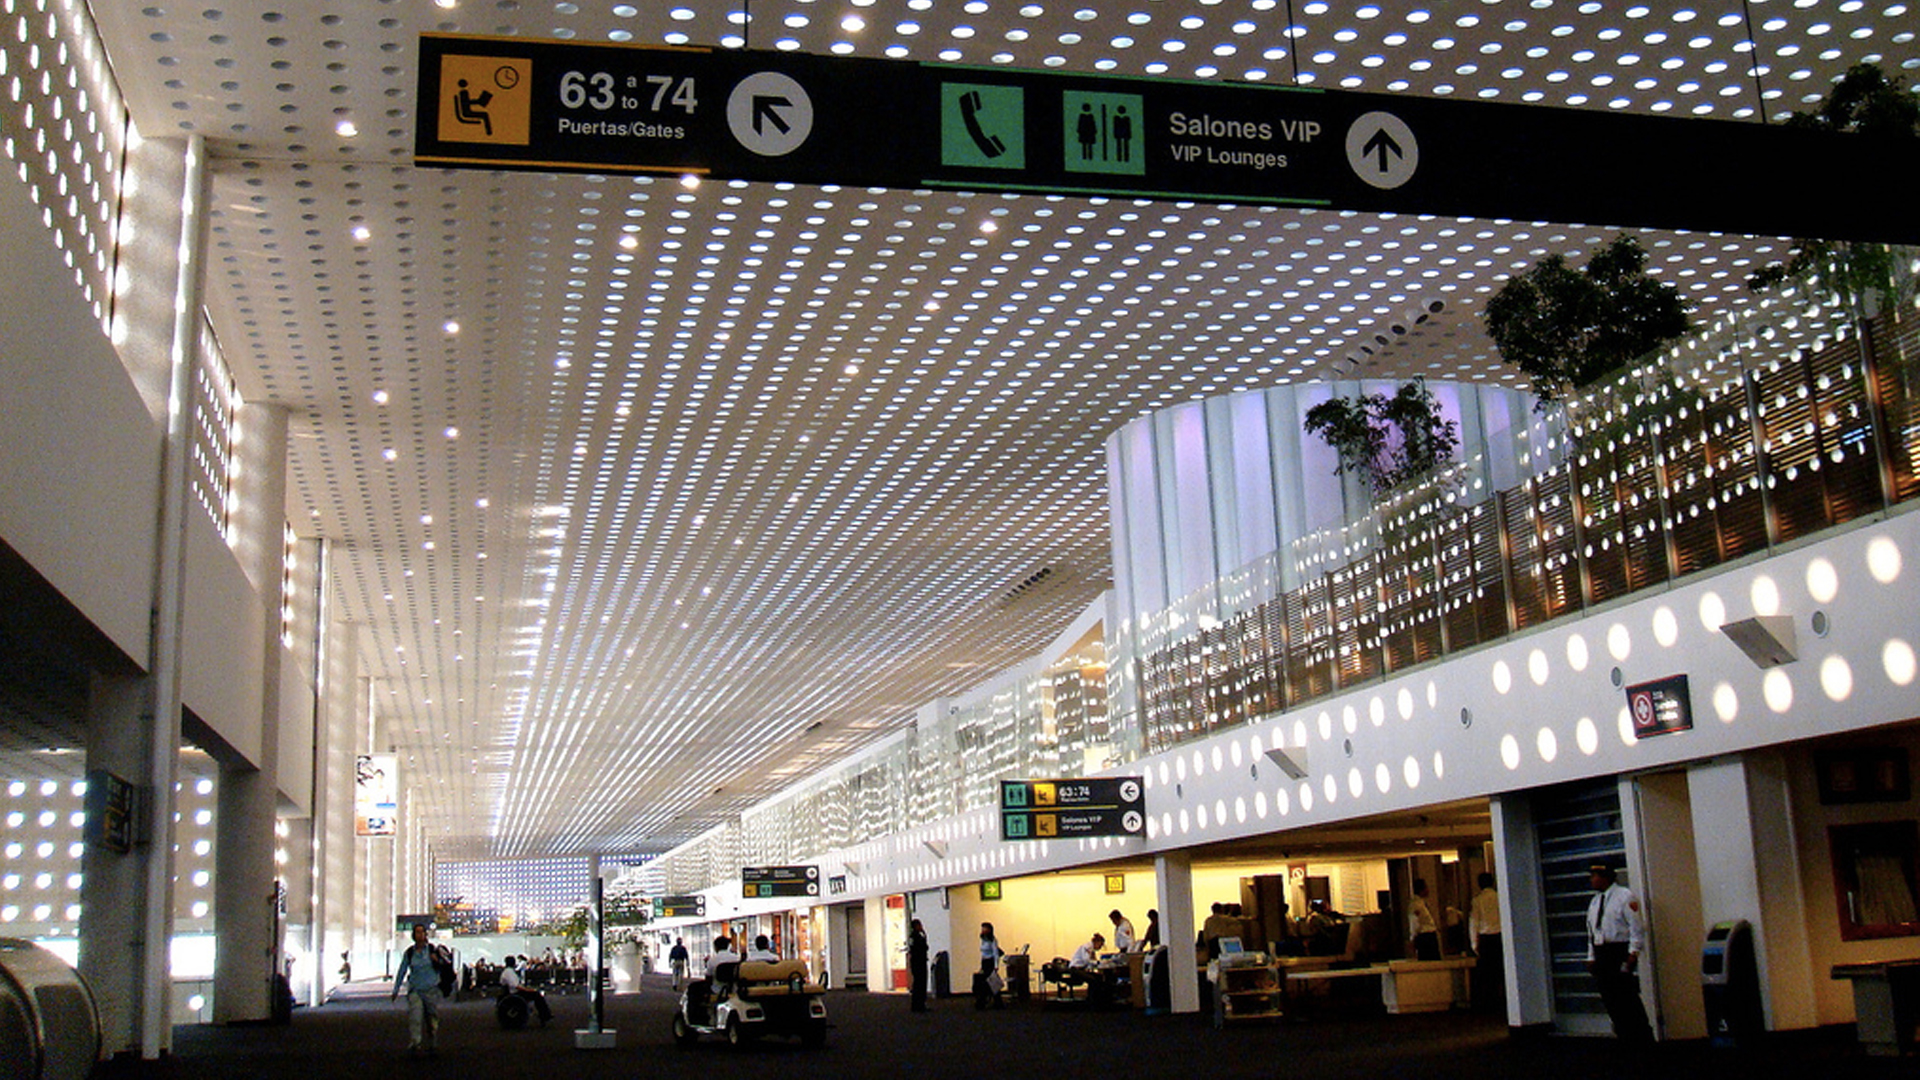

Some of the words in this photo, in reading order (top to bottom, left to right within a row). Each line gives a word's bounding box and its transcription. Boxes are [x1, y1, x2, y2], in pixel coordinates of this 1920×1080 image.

[559, 71, 615, 110] 63
[627, 76, 637, 88] a
[621, 96, 638, 109] to
[646, 75, 698, 114] 74
[557, 118, 685, 139] Puertas/Gates
[1169, 112, 1272, 140] Salones
[1281, 119, 1321, 142] VIP
[1171, 145, 1201, 161] VIP
[1207, 147, 1287, 169] Lounges
